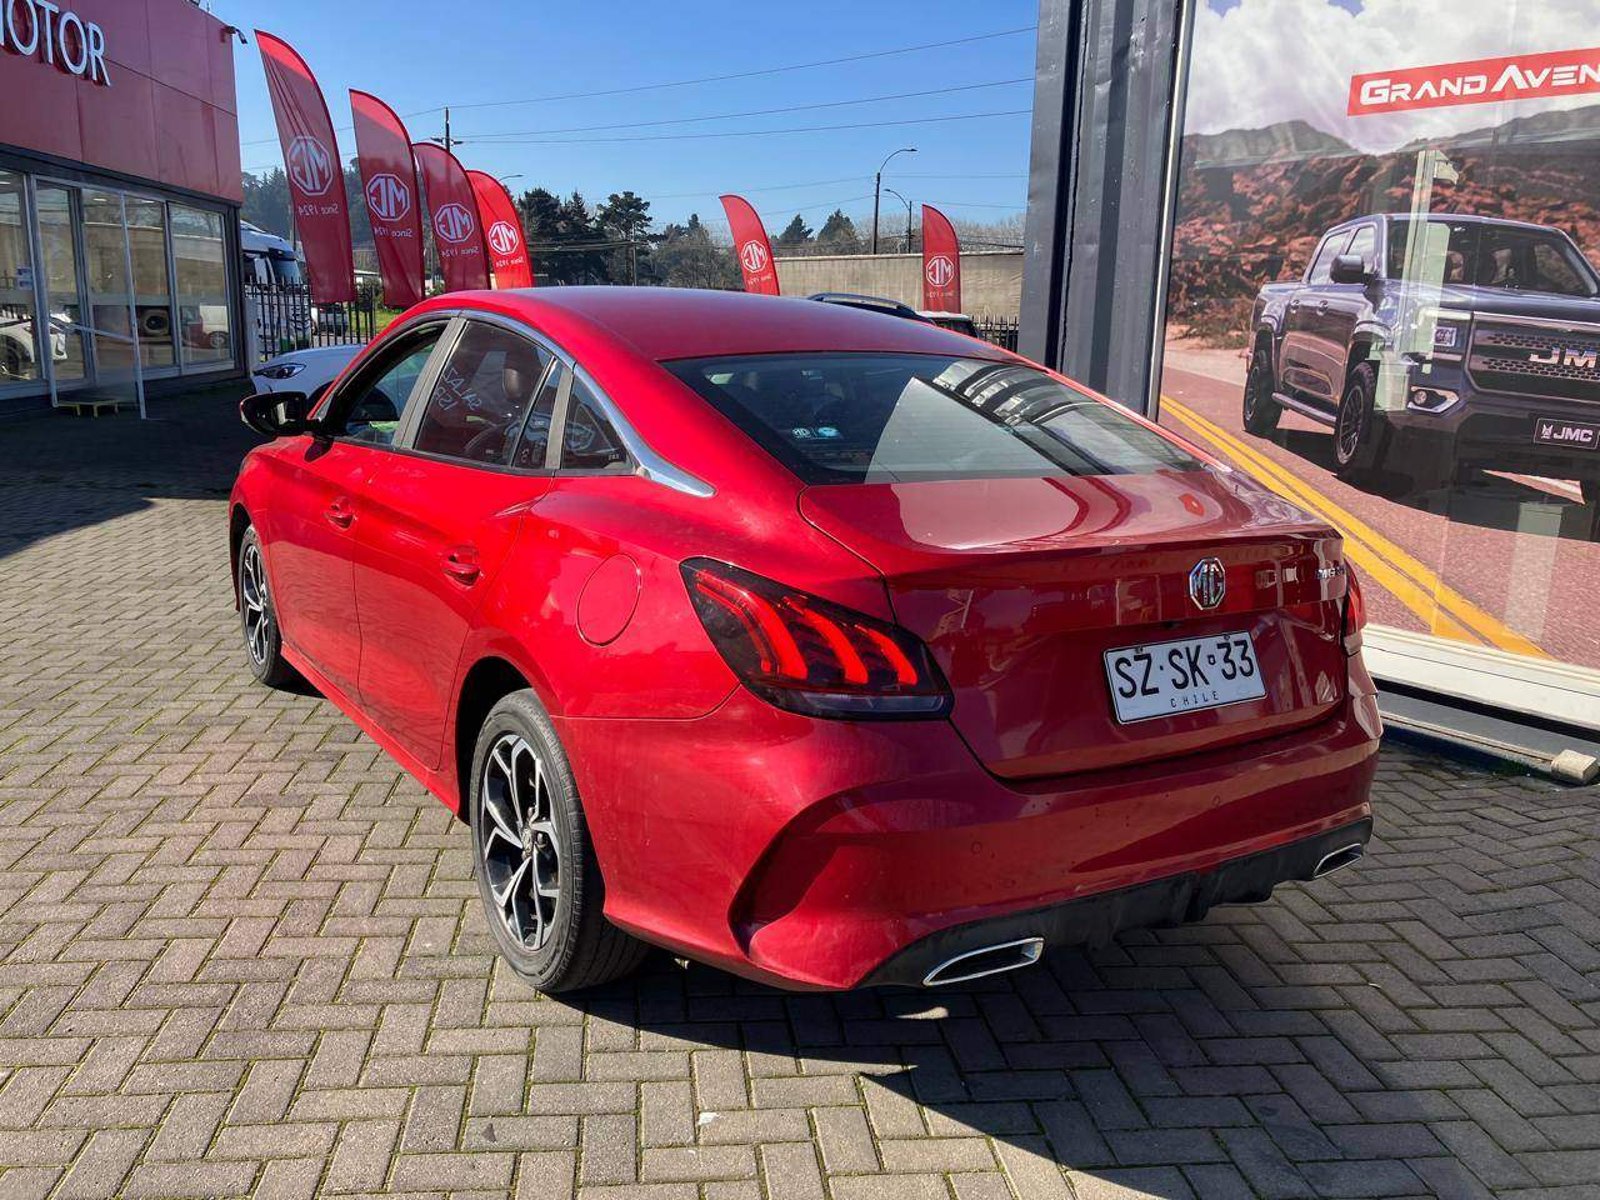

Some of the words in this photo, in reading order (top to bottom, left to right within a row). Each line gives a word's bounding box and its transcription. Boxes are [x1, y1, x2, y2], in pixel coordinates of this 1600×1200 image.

[0, 0, 110, 86] OTOR
[1360, 75, 1487, 106] GRAND
[1553, 426, 1594, 442] JMC
[1191, 560, 1225, 608] MG
[1170, 690, 1220, 708] CHILE
